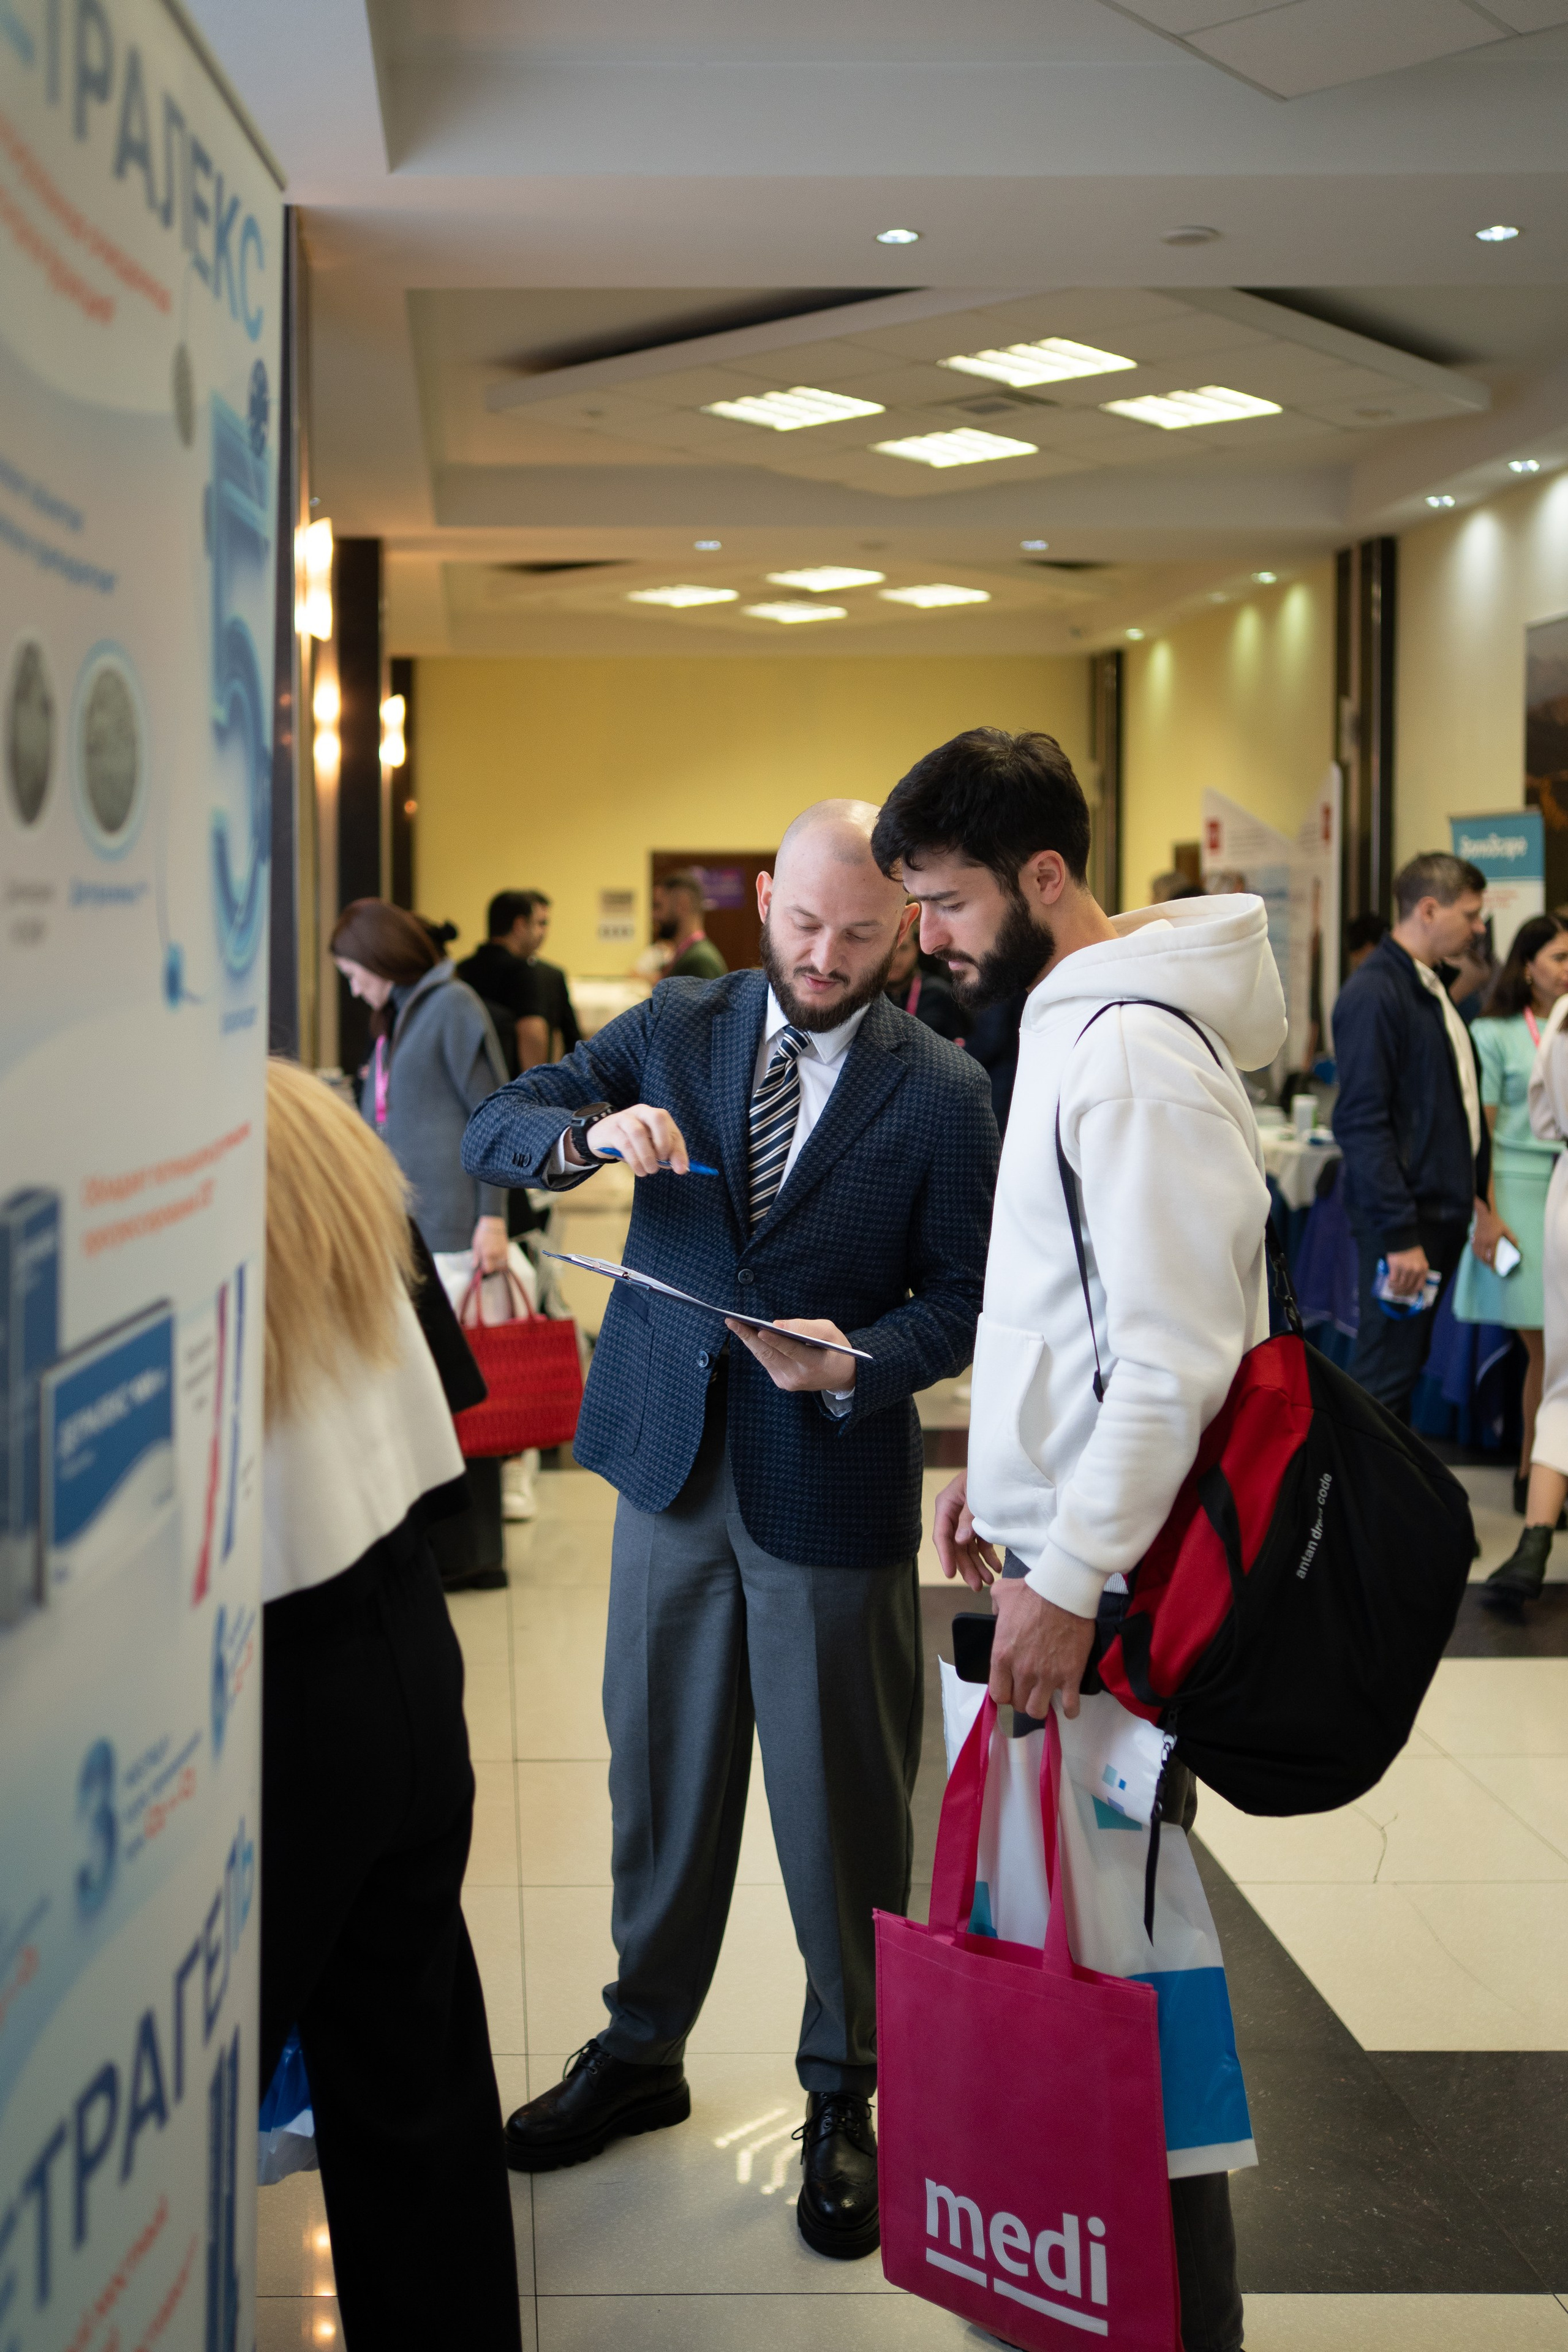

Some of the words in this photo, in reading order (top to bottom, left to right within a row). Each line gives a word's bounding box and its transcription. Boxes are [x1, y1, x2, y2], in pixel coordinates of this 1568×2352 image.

[1296, 1540, 1318, 1579] antan
[1317, 1473, 1332, 1505] code
[925, 2177, 1108, 2307] medi
